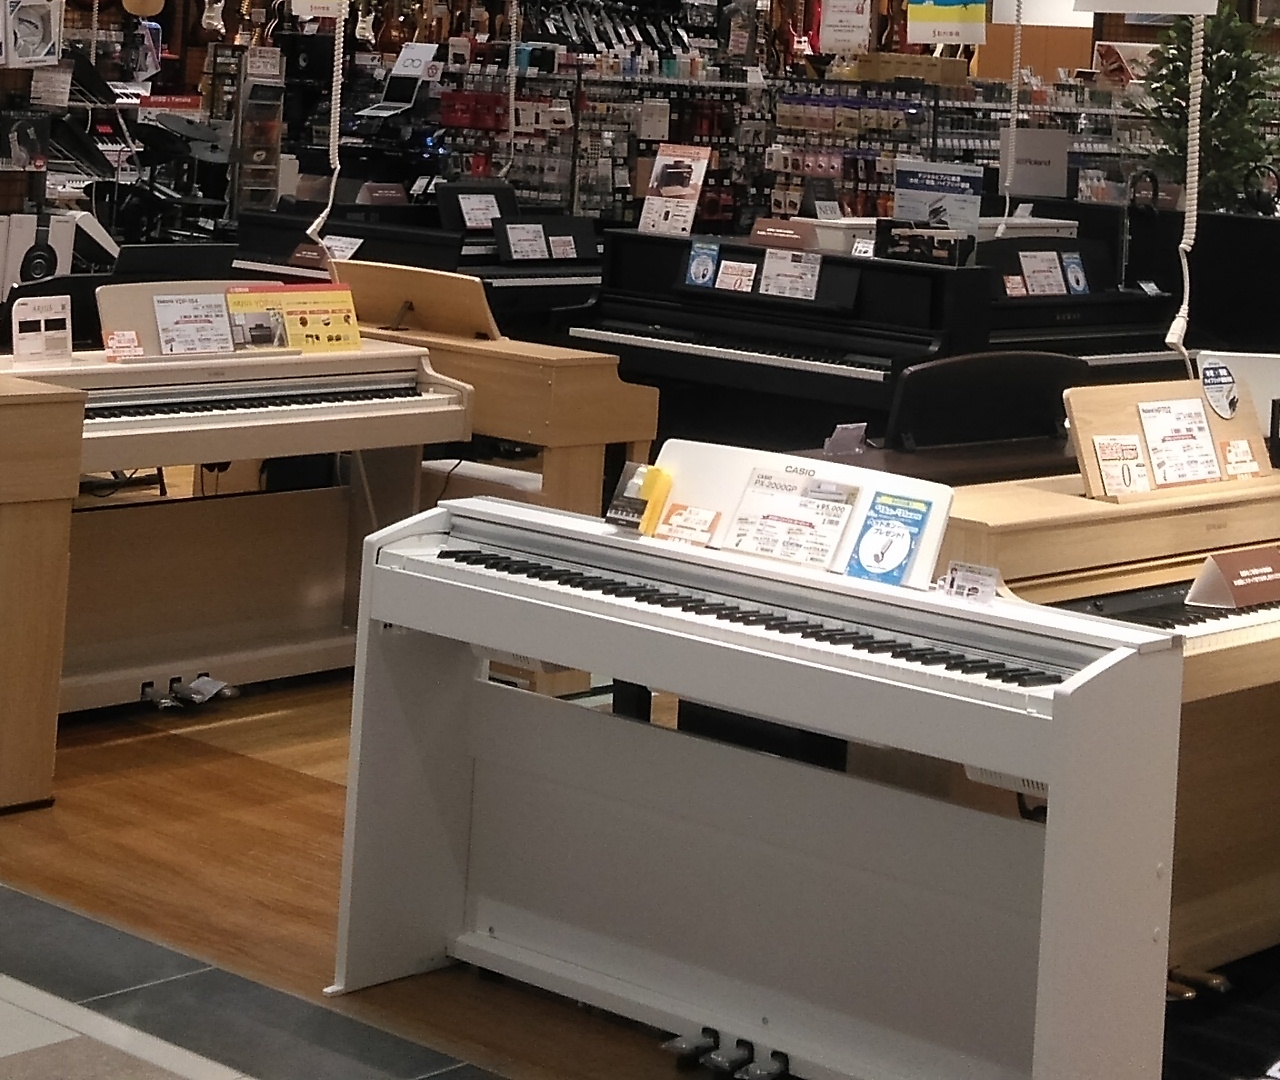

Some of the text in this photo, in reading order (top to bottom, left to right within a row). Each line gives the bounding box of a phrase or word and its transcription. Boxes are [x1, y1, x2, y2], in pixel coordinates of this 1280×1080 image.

[1025, 159, 1051, 167] Roland
[784, 465, 816, 477] CASIO
[754, 480, 798, 492] PX-2000GP
